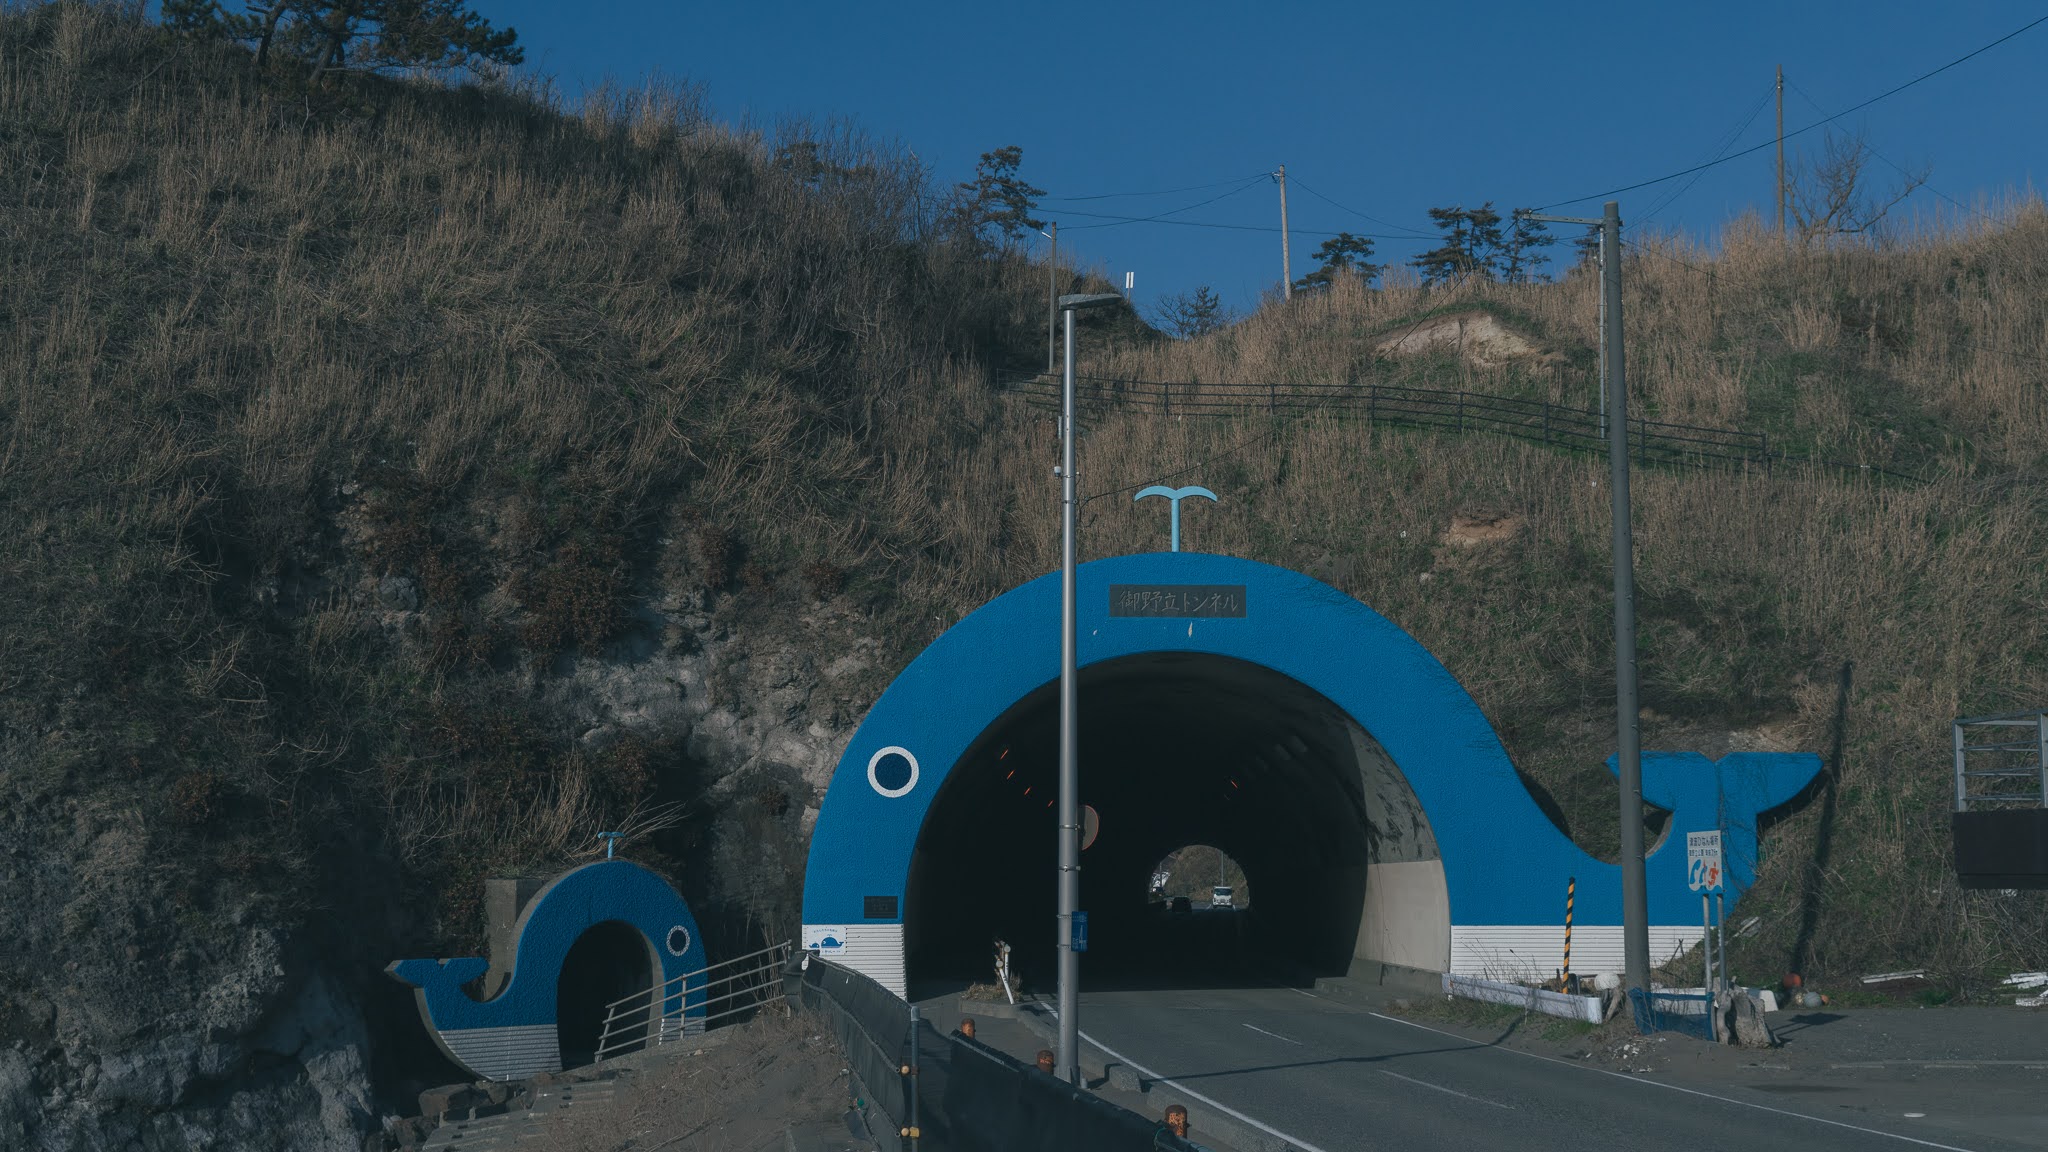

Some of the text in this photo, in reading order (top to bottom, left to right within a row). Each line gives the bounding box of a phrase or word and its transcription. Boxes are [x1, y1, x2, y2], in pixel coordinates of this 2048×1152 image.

[1118, 590, 1239, 613] 御野立トンネル
